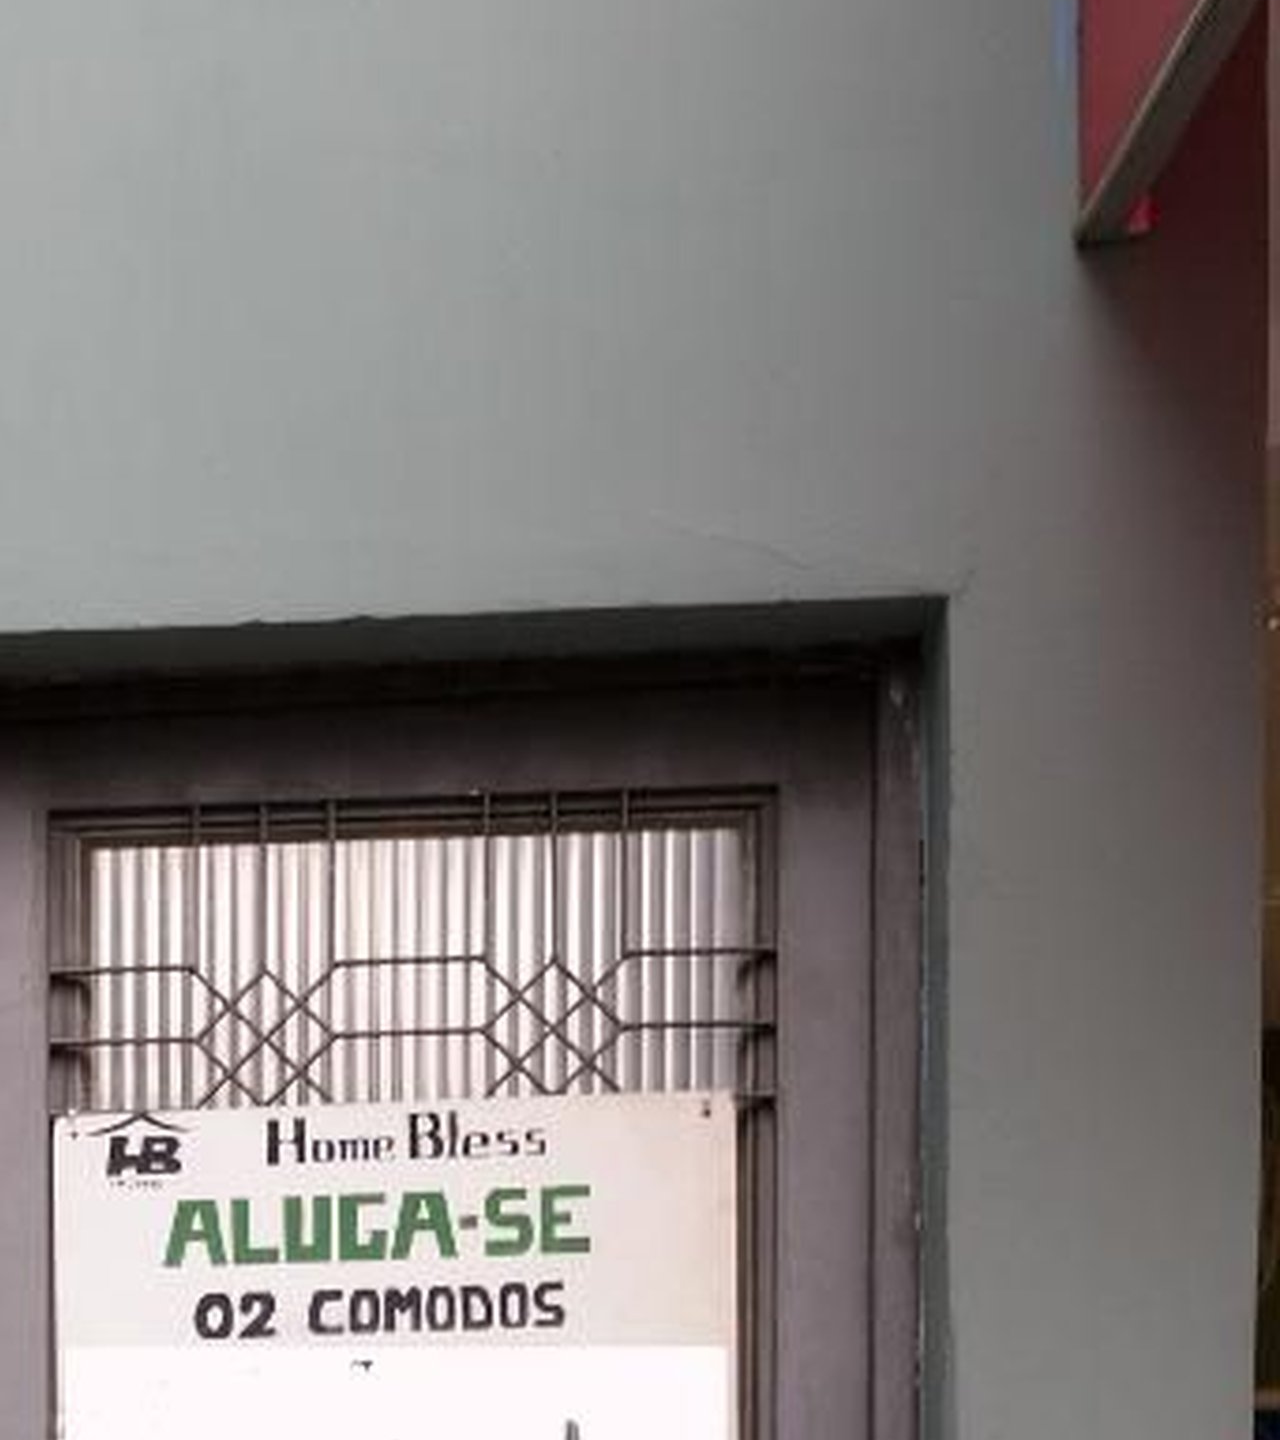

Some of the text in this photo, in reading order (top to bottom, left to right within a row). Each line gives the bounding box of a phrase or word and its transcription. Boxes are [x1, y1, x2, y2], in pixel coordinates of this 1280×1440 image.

[266, 1110, 547, 1165] Home Bless
[162, 1184, 592, 1267] ALUGA-SE
[193, 1280, 567, 1339] 02 COMODOS
